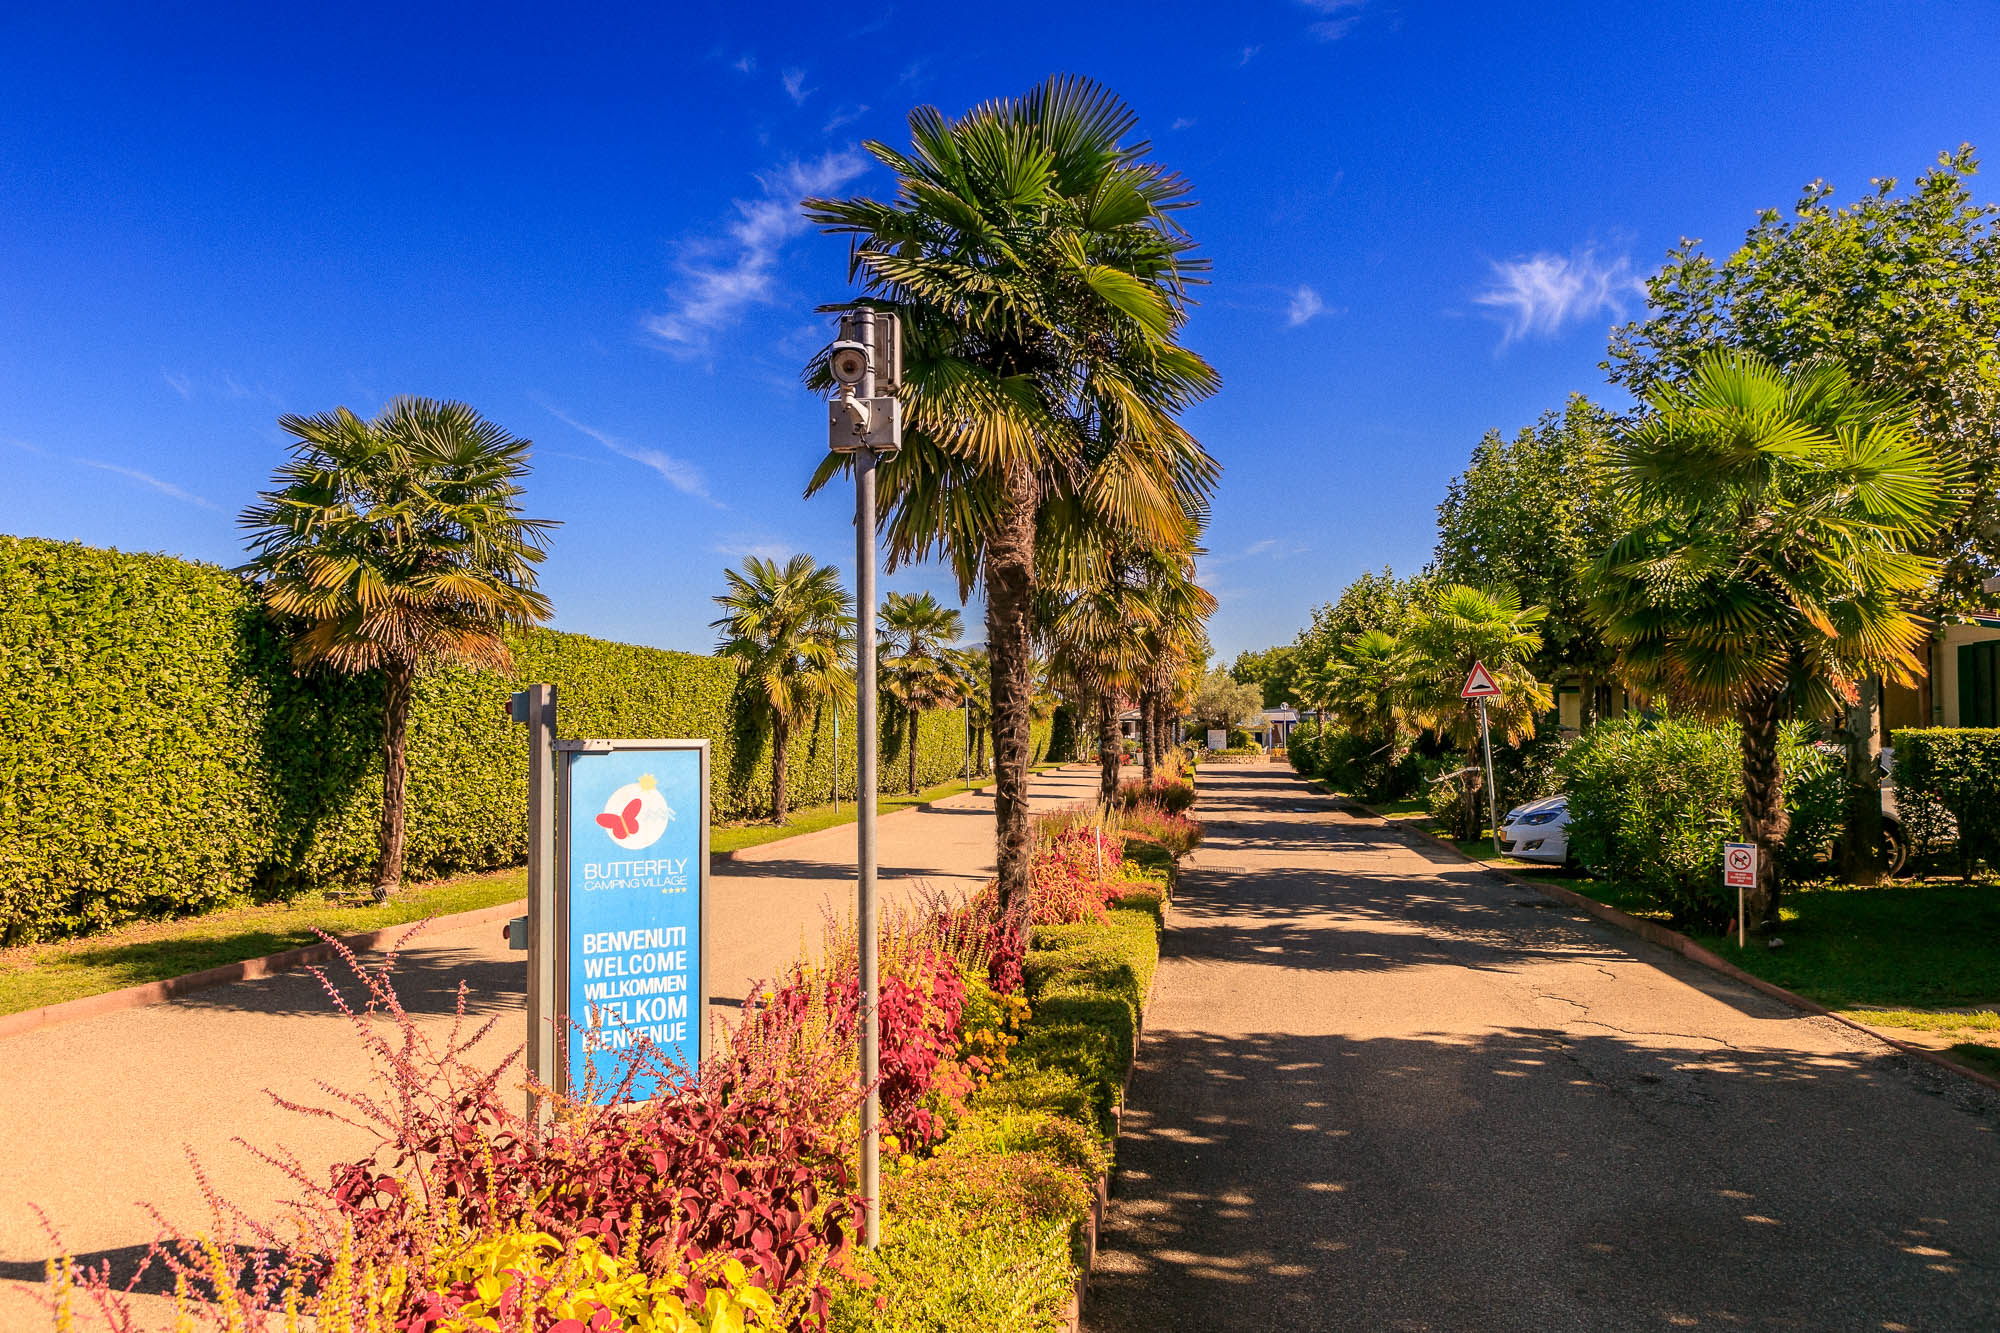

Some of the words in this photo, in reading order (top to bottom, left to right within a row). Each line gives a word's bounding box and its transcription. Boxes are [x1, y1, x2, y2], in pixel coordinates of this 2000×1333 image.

[584, 858, 688, 880] BUTTERFLY
[584, 878, 640, 891] CAMPING
[641, 875, 687, 887] VILLAGE
[584, 926, 686, 954] BENVENUTI
[584, 950, 687, 979] WELCOME
[584, 974, 687, 1000] WILLKOMMEN
[584, 995, 687, 1028] WELKOM
